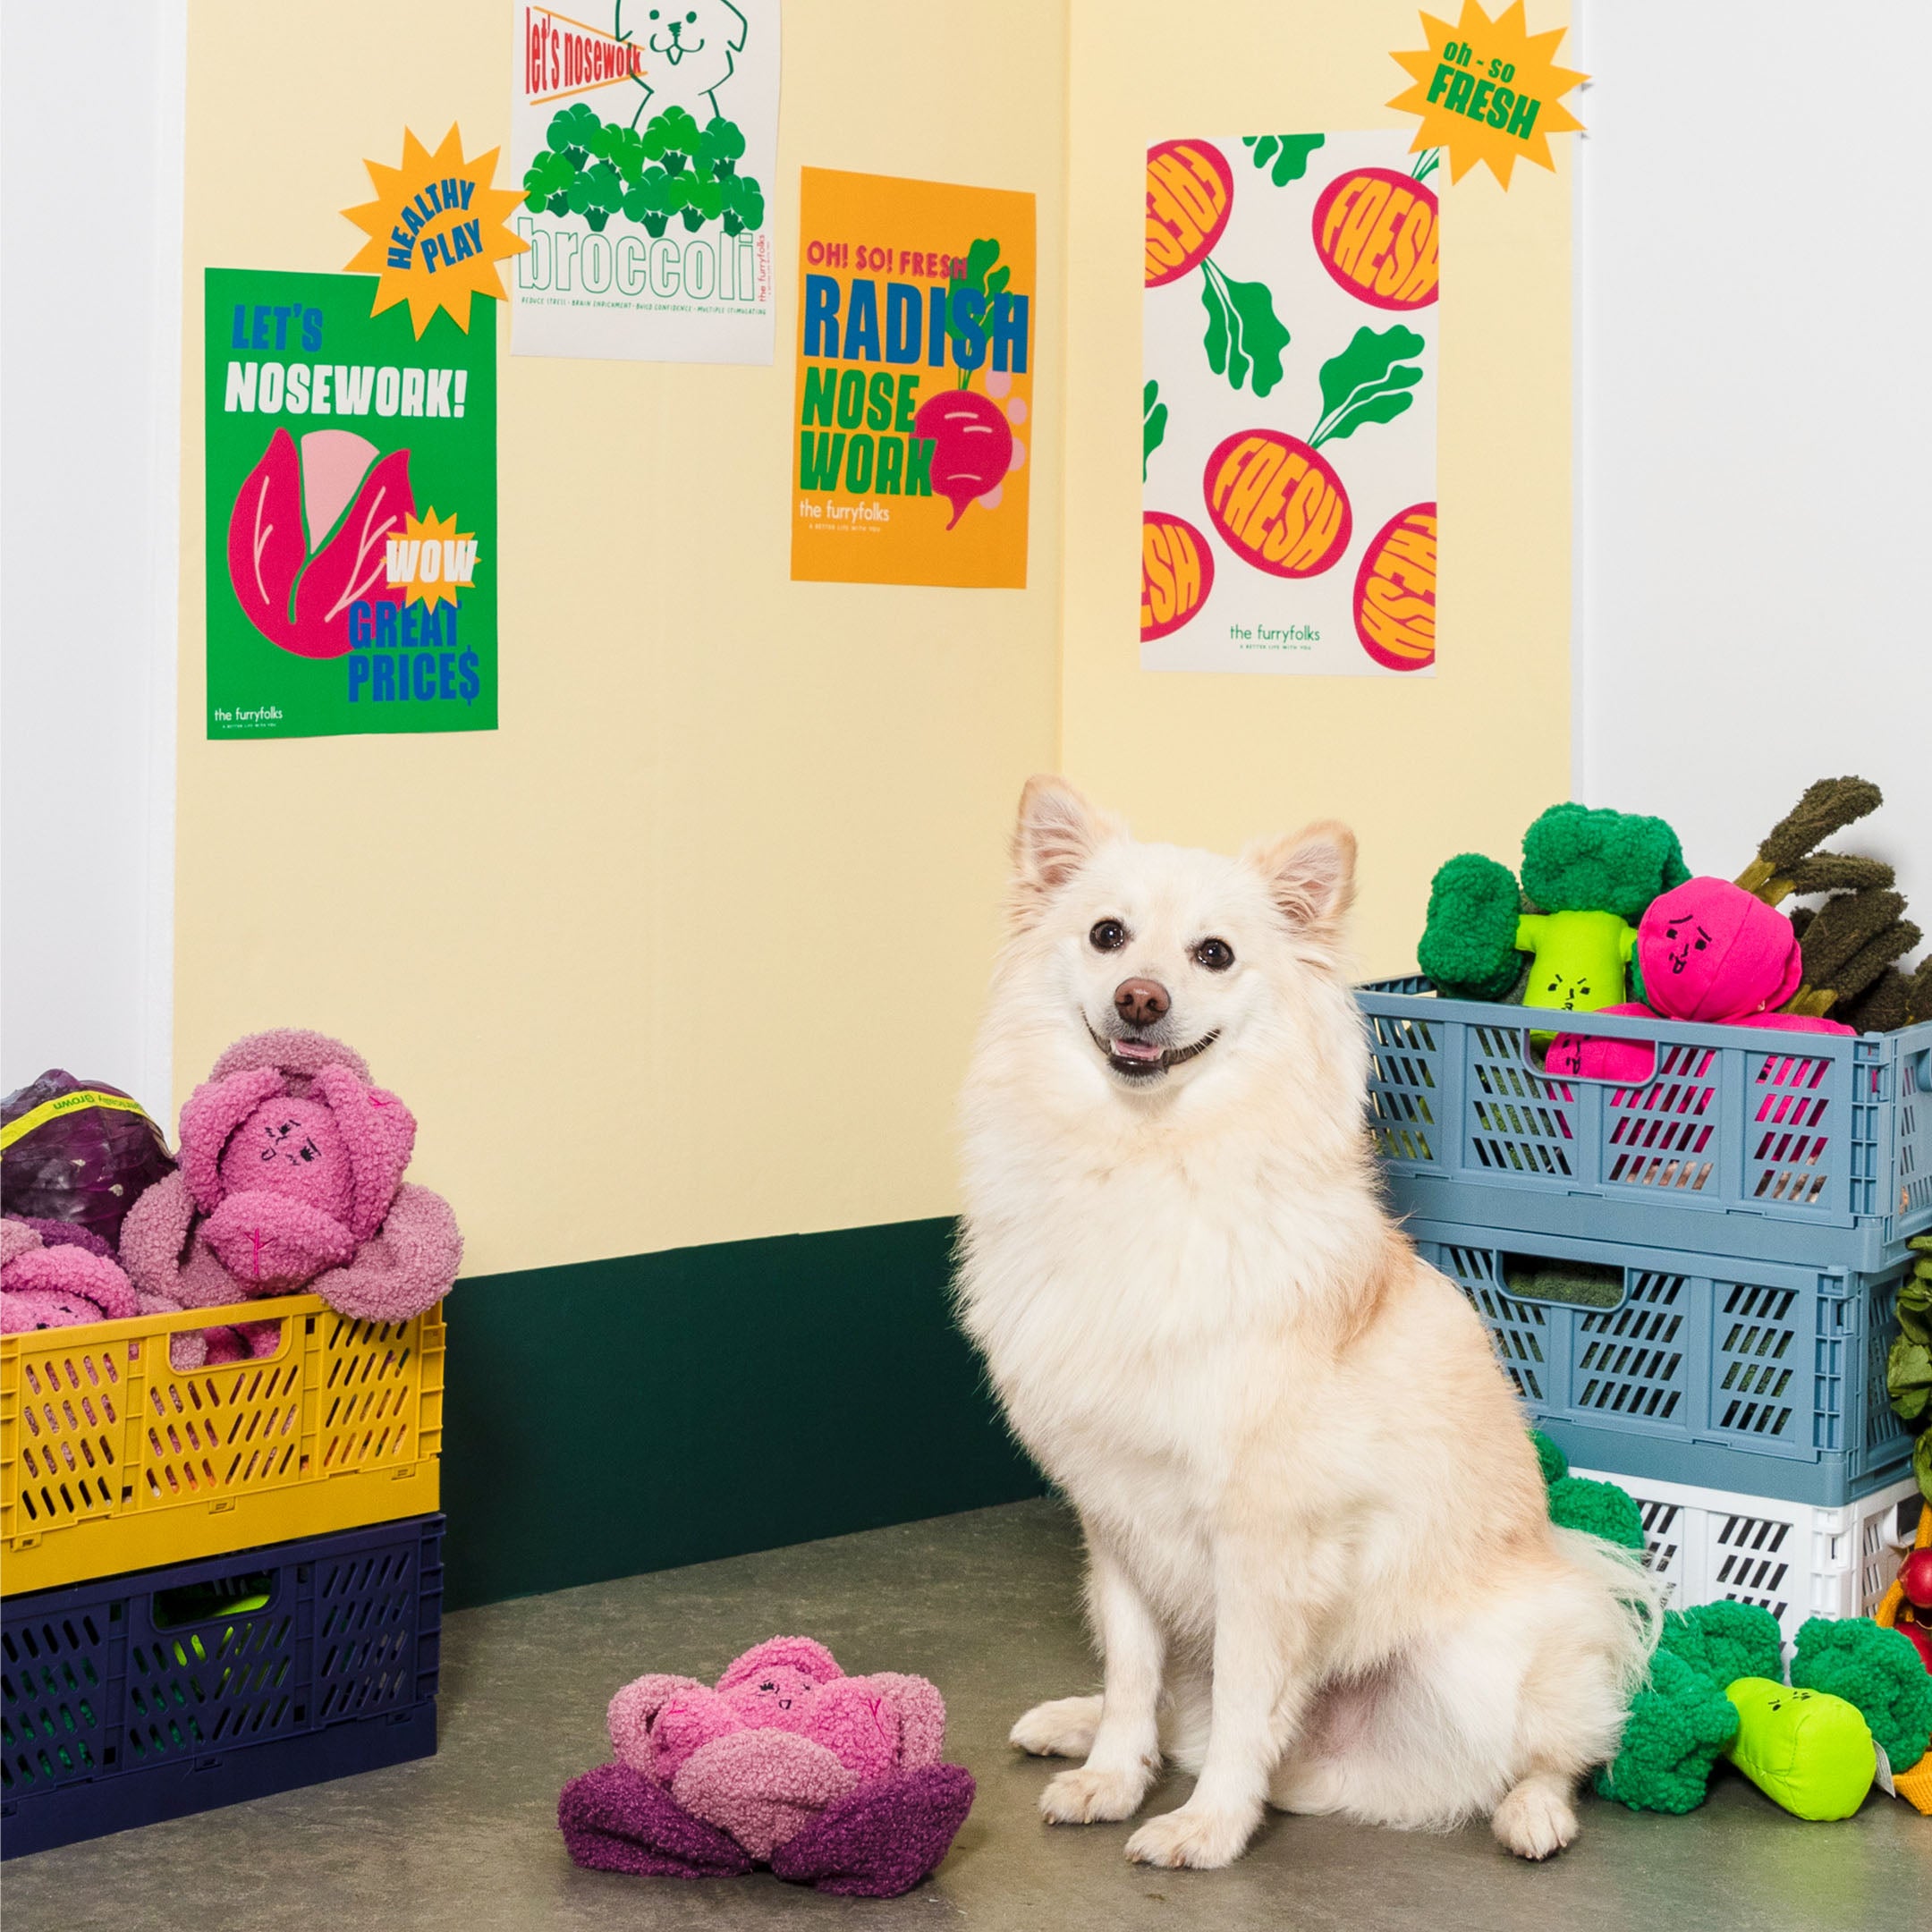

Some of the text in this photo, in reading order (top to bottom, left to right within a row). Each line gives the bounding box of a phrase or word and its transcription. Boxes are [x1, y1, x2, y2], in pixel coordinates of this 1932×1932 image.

[525, 6, 641, 94] let's nosework
[1443, 41, 1472, 67] oh
[1487, 58, 1515, 83] so
[1426, 63, 1541, 140] FRESH
[386, 177, 475, 269] HEALTHY
[1145, 145, 1226, 281] FRES
[1322, 176, 1438, 302] FRESH
[420, 218, 483, 274] PLAY
[517, 216, 755, 301] broccoli
[807, 240, 849, 269] OH!
[855, 244, 894, 275] SO!
[899, 250, 968, 281] FRESH
[758, 285, 766, 302] the
[231, 302, 323, 353] LET'S
[803, 273, 1029, 374] RADISH
[224, 361, 468, 418] NOSEWORK!
[801, 366, 919, 433] NOSE
[800, 430, 937, 497] WORK
[799, 497, 890, 524] the furryfolks
[1212, 436, 1343, 571] FRESH
[386, 538, 478, 583] WOW
[348, 599, 462, 649] GREAT
[1230, 623, 1320, 643] the furryfolks
[215, 706, 284, 723] the furryfolks
[54, 1094, 95, 1110] Grown
